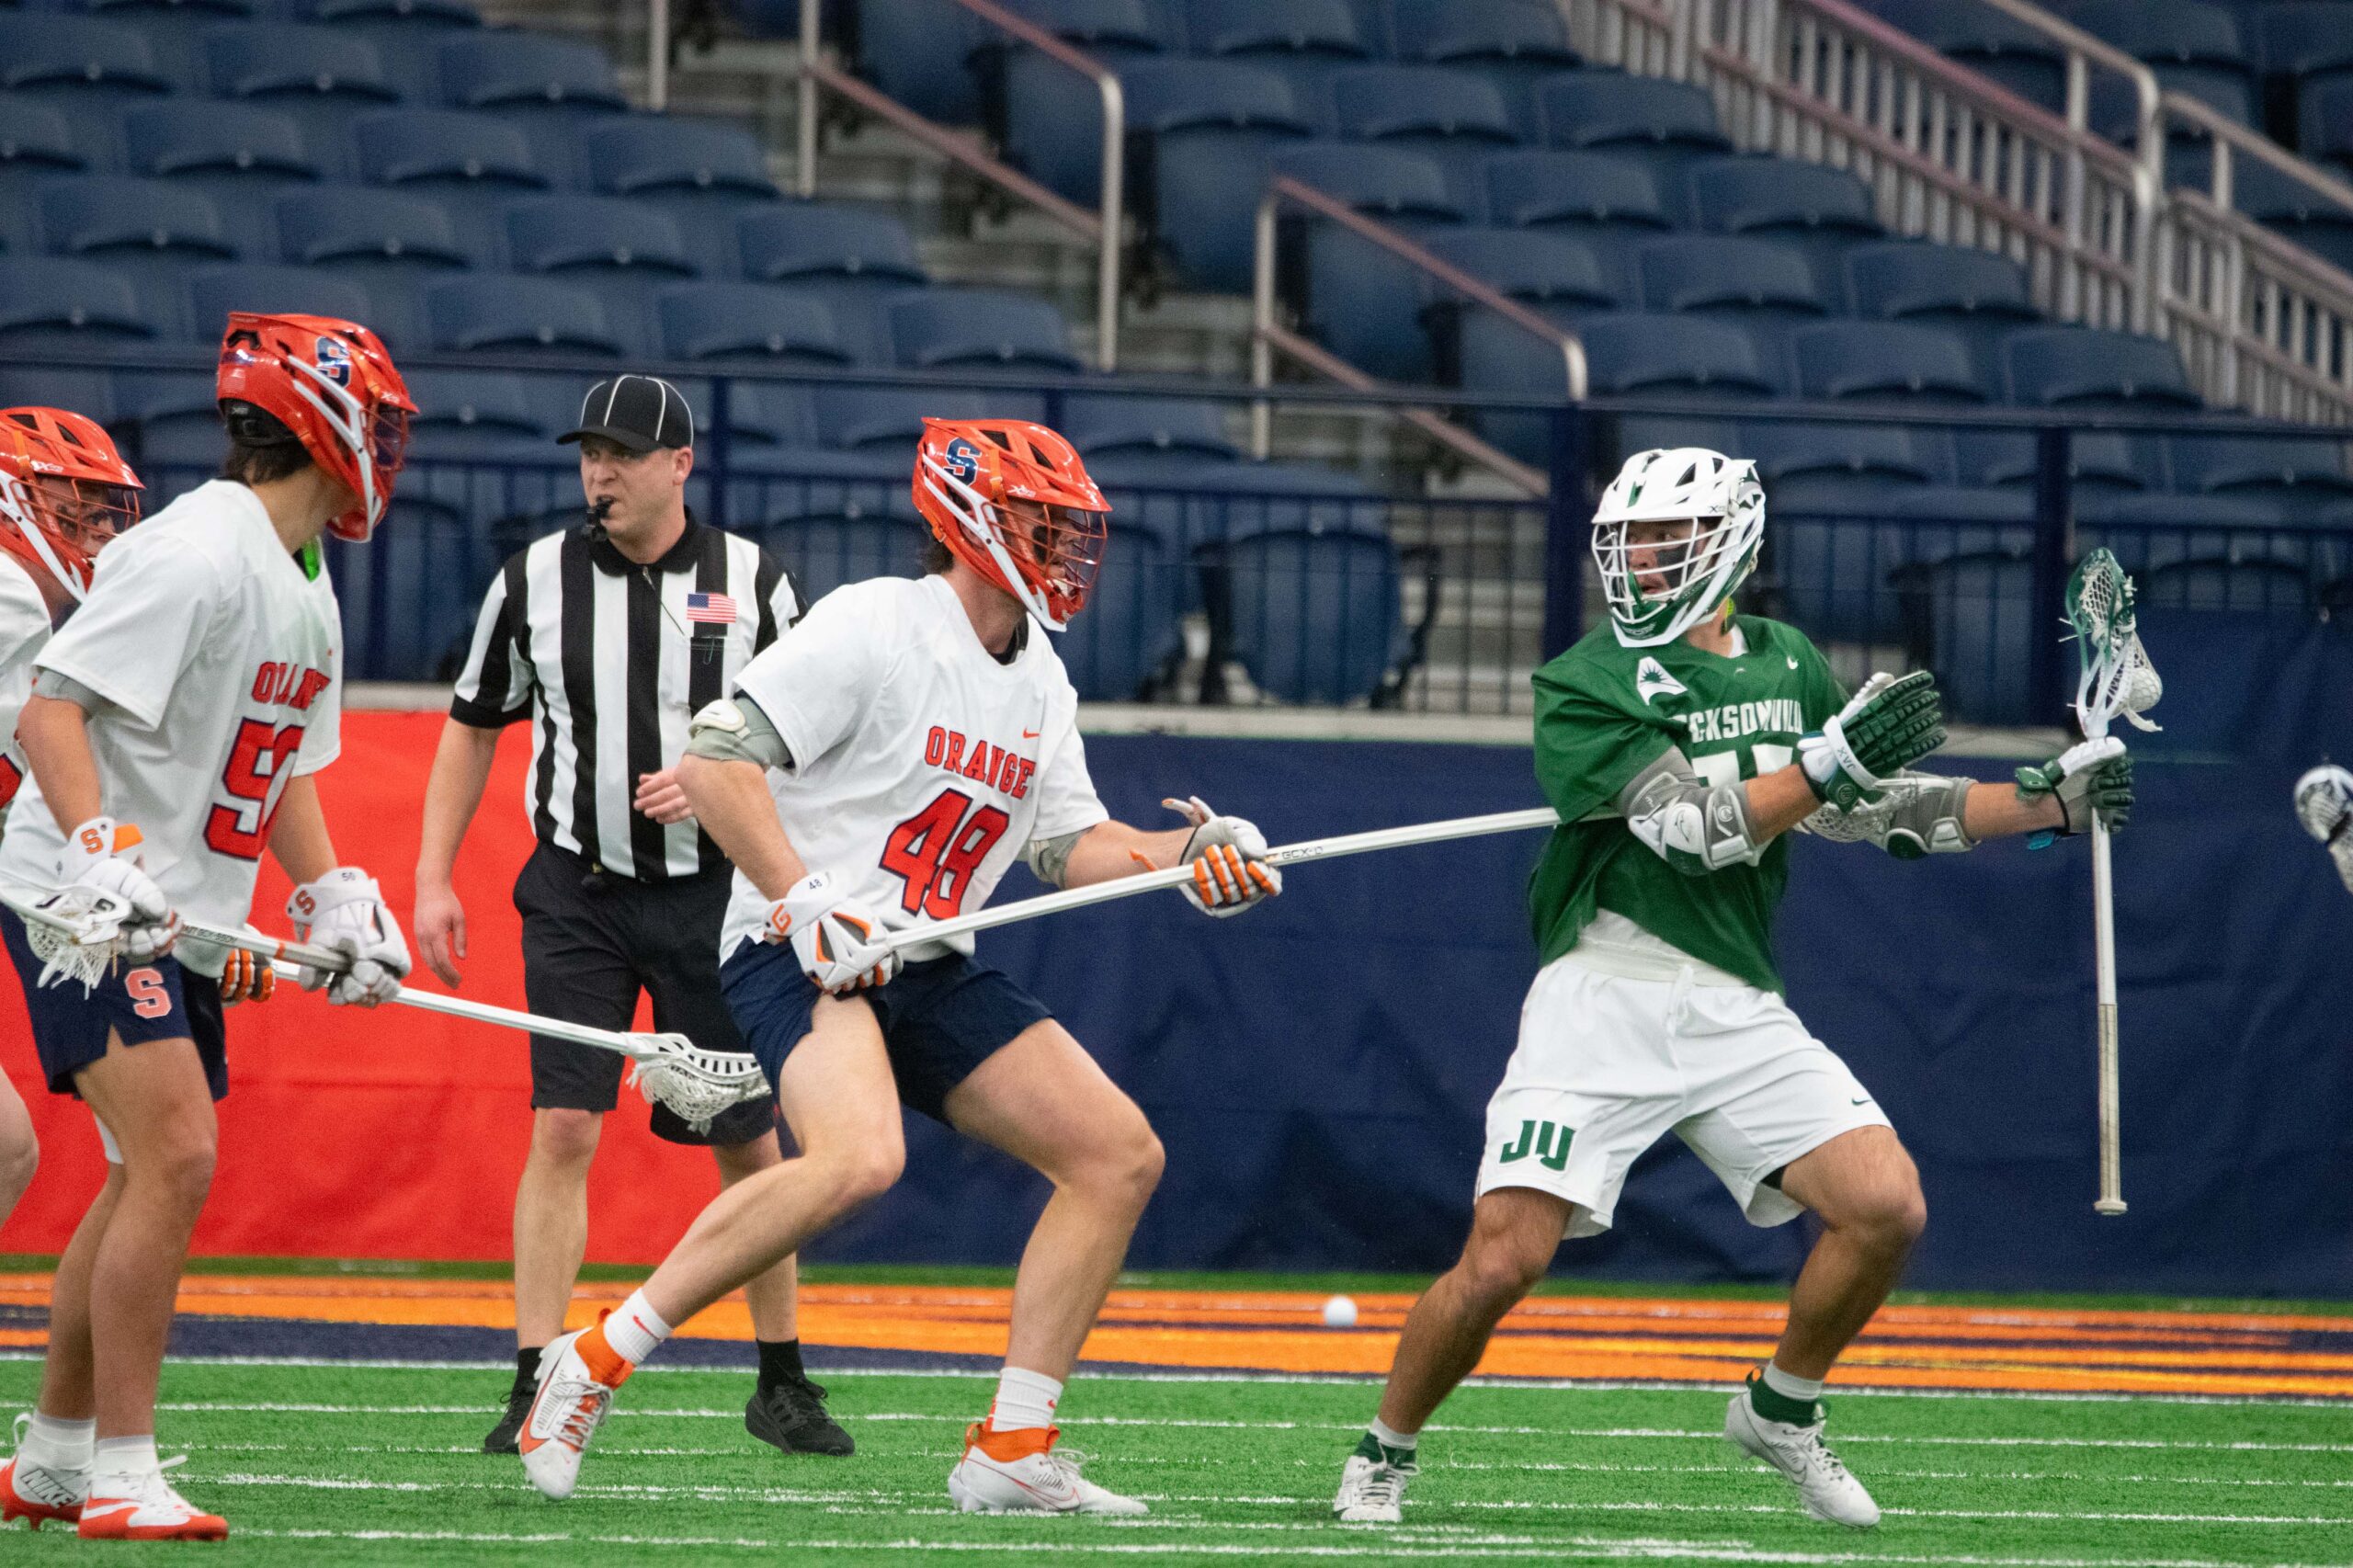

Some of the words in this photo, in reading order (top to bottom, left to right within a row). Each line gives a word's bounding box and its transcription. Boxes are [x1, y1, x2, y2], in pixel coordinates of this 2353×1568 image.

[943, 437, 983, 487] S
[924, 725, 1037, 800] ORANGE
[80, 828, 104, 855] S
[878, 787, 1010, 922] 48
[295, 890, 316, 916] S
[124, 968, 172, 1019] S
[1499, 1119, 1576, 1172] JU
[19, 1468, 77, 1509] NIKE
